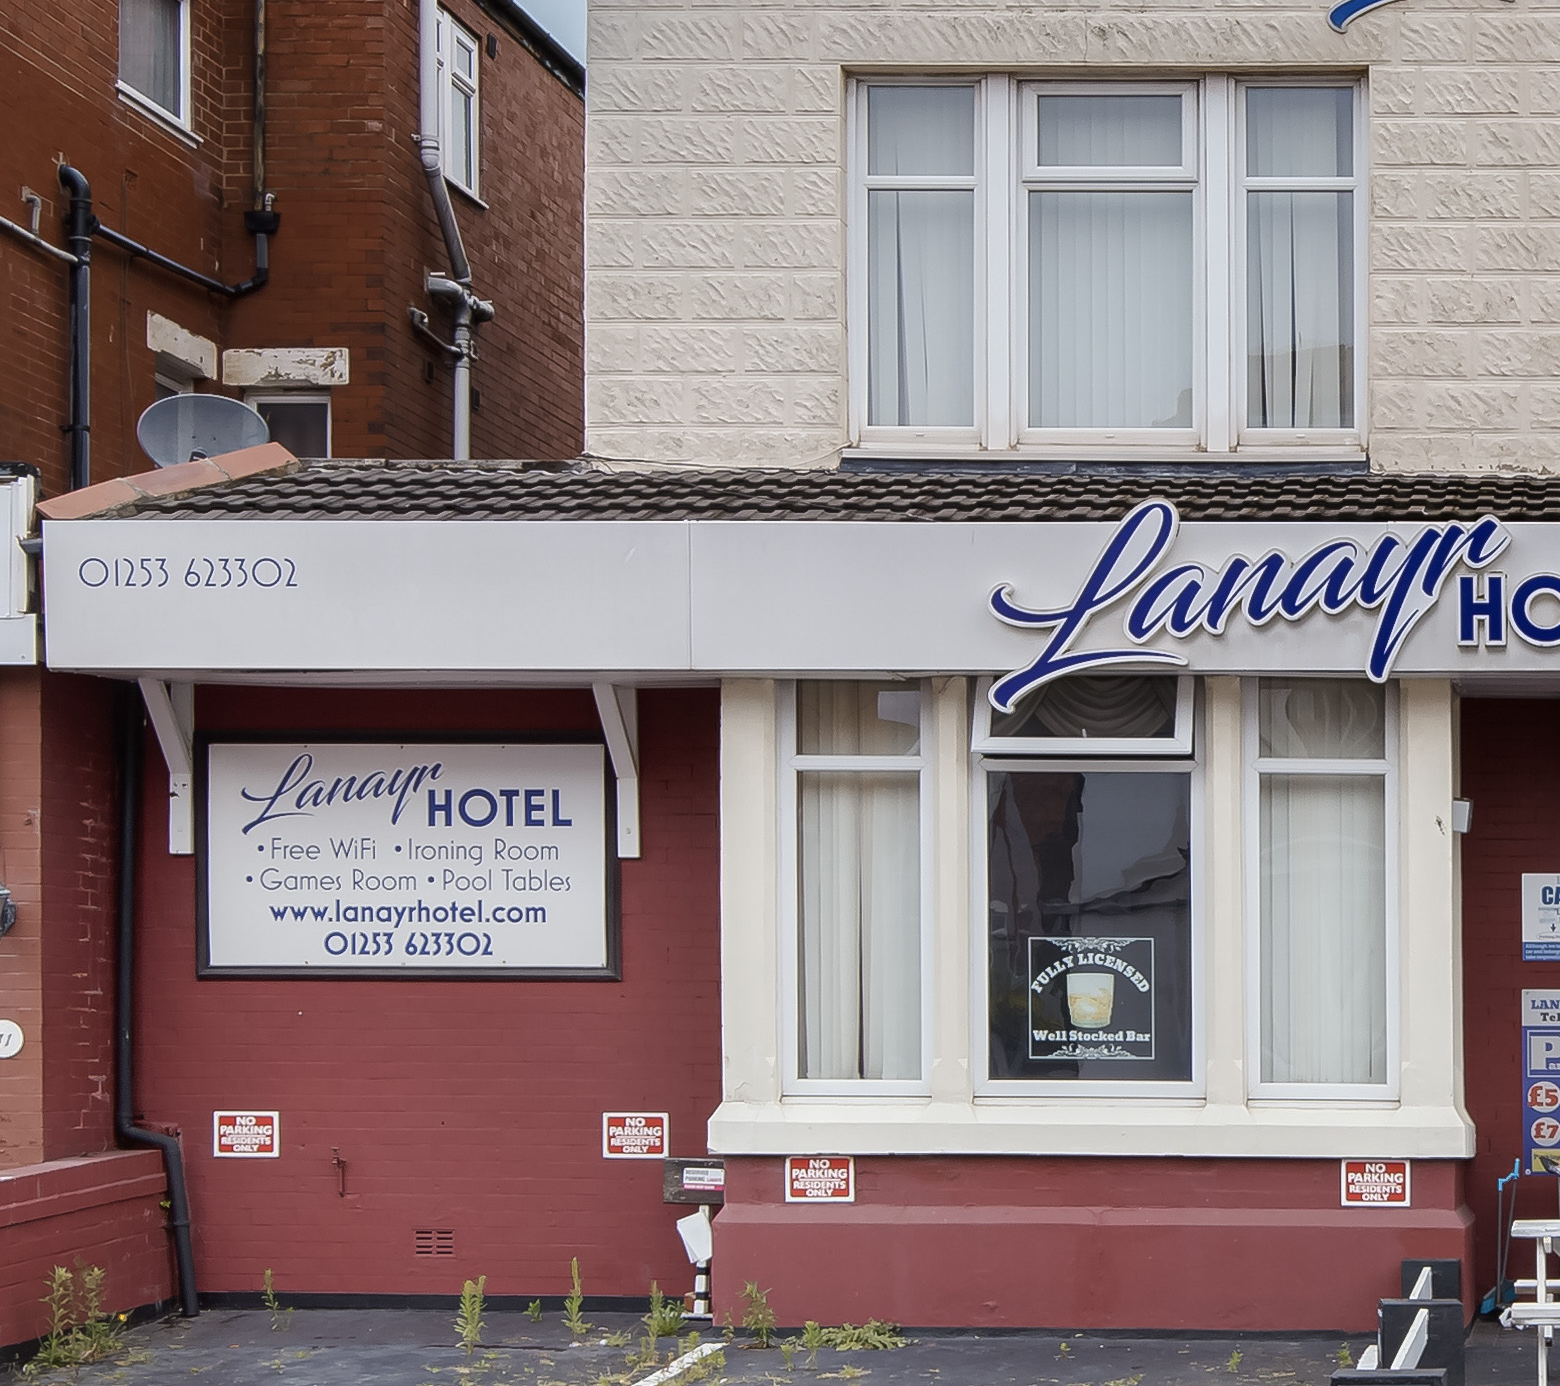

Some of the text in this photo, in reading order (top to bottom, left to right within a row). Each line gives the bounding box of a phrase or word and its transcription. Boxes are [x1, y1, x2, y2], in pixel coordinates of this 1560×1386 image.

[79, 557, 298, 588] 01253 623302
[988, 499, 1513, 714] Lanayr
[241, 753, 573, 835] Lanayr HOTEL
[271, 838, 559, 866] Free WiFi Ironing Room
[260, 868, 571, 891] Games Room Pool Tables
[269, 899, 547, 928] www.lanayrhotel.com
[324, 931, 493, 955] 01253 623302
[1031, 953, 1150, 993] FULLY LICENSED
[1033, 1030, 1151, 1042] Well Stocked Bar
[1528, 1086, 1559, 1107] £5
[235, 1116, 257, 1125] NO
[625, 1117, 646, 1126] NO
[220, 1125, 272, 1135] PARKING
[609, 1126, 662, 1136] PARKING
[1533, 1122, 1559, 1139] £7
[221, 1137, 272, 1145] RESIDENTS
[610, 1138, 661, 1146] RESIDENTS
[233, 1144, 260, 1152] ONLY
[809, 1159, 830, 1169] NO
[1365, 1163, 1386, 1173] NO
[792, 1169, 848, 1179] PARKING
[1348, 1173, 1404, 1183] PARKING
[793, 1181, 846, 1189] RESIDENTS
[1349, 1185, 1402, 1193] RESIDENTS
[805, 1189, 834, 1197] ONLY
[1362, 1193, 1390, 1201] ONLY
